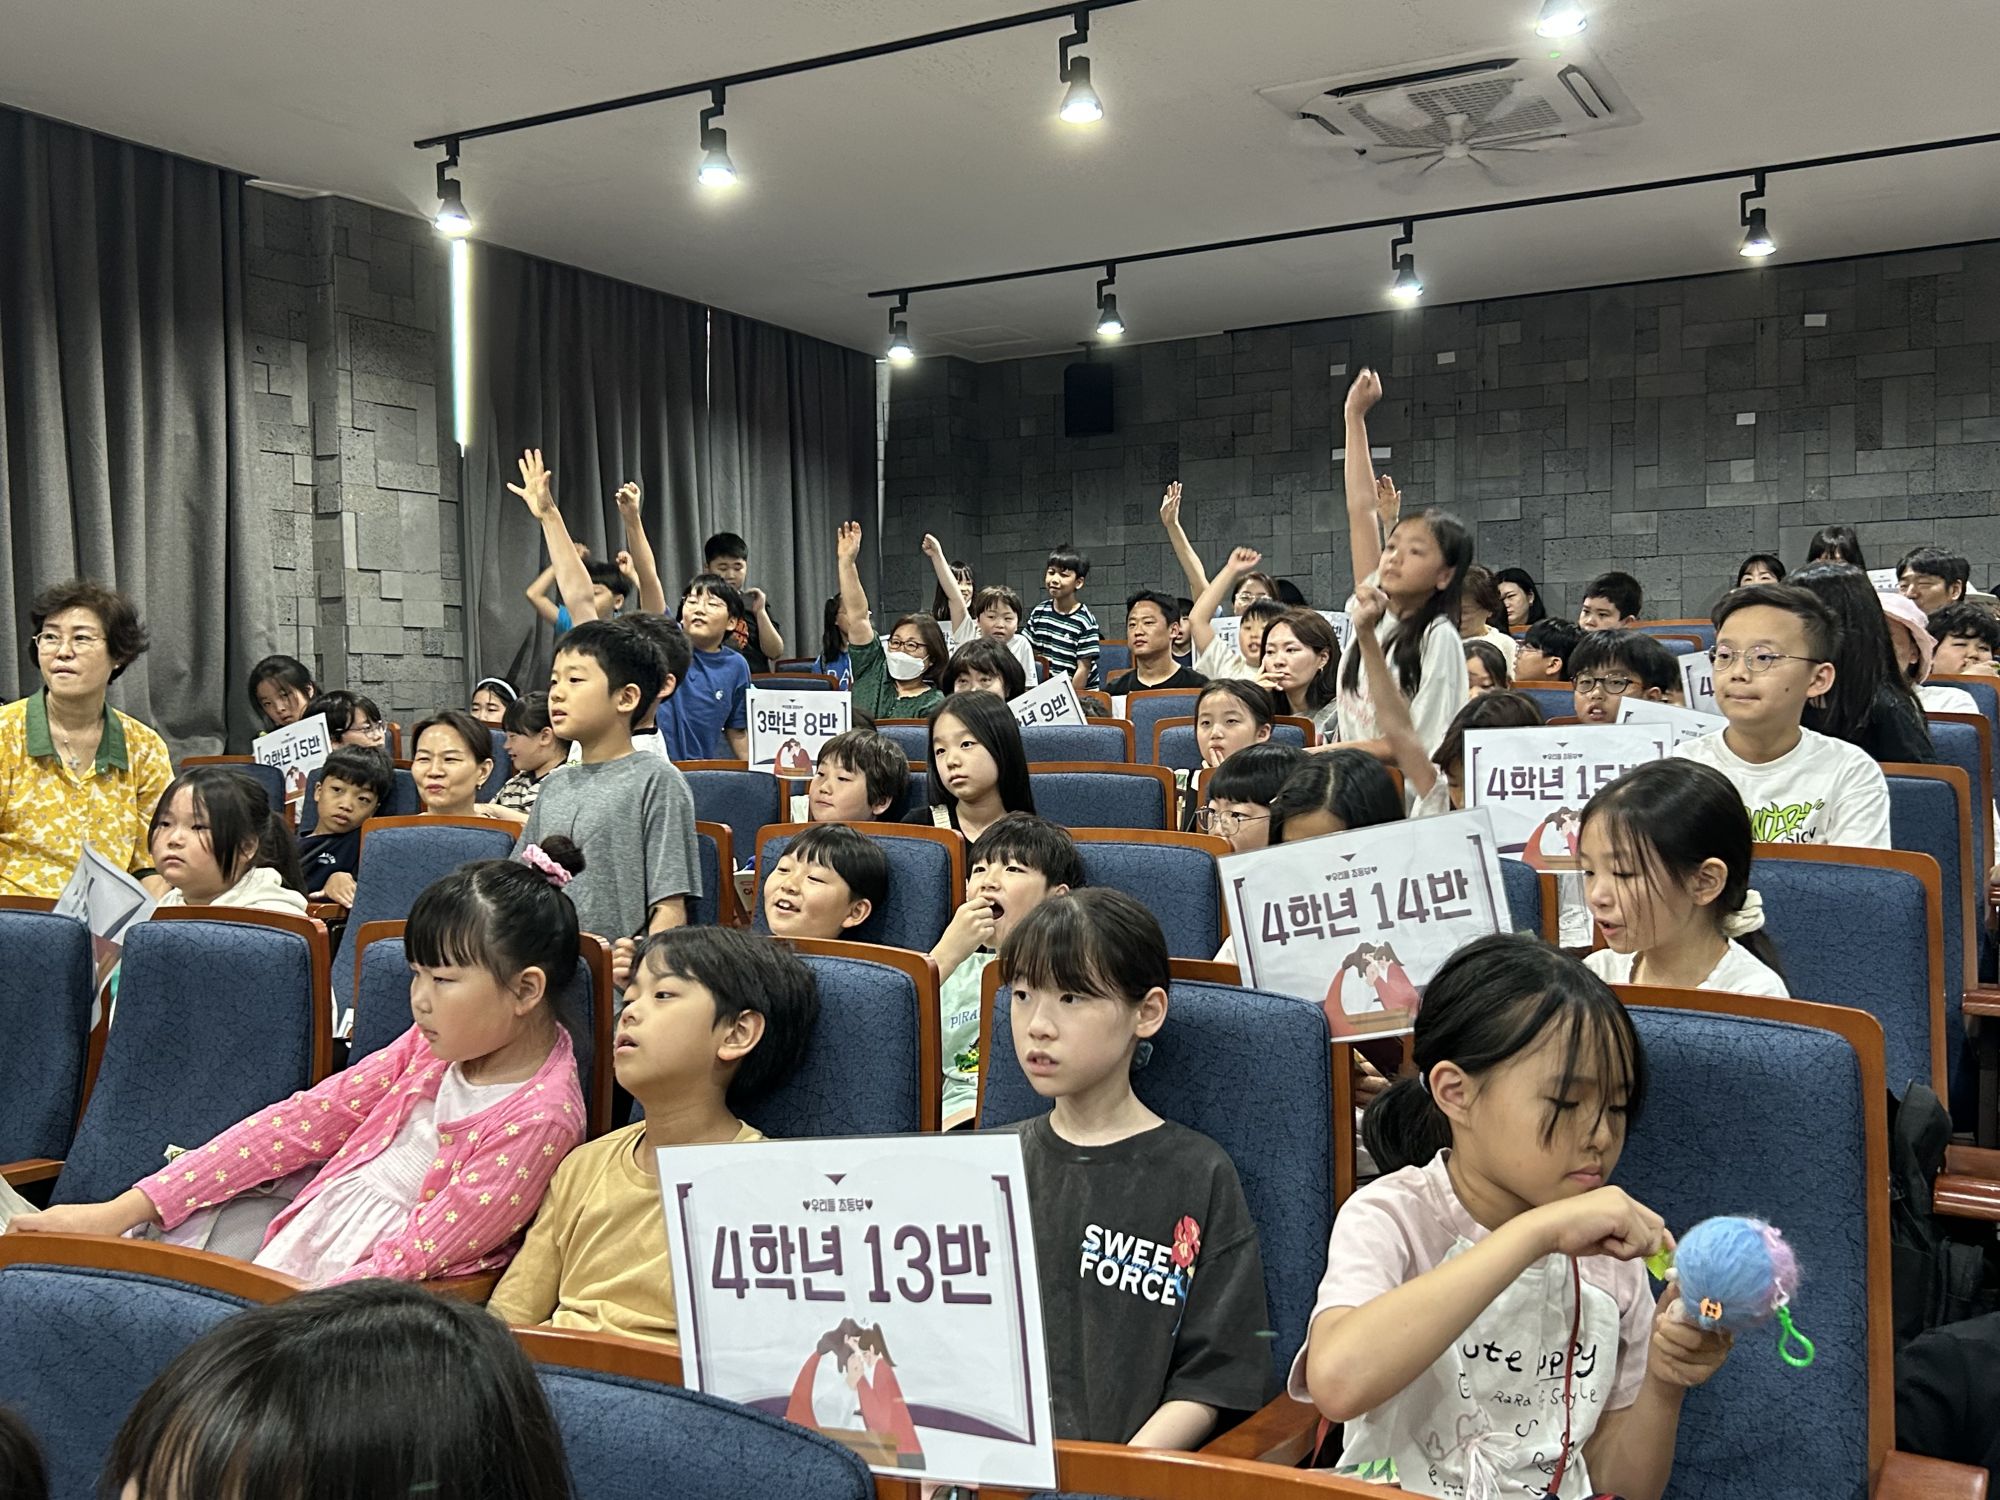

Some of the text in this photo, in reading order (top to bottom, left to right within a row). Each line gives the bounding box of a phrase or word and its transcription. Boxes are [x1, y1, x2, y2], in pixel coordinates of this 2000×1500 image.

[1041, 694, 1070, 722] 9반
[757, 711, 838, 736] 3학년 8반
[294, 735, 321, 760] 15반
[1487, 766, 1564, 800] 4학년
[1262, 869, 1472, 946] 4학년 14반
[950, 1009, 979, 1028] PIRA
[812, 1199, 864, 1212] 우리들 초등부
[712, 1225, 846, 1300] 4학년
[864, 1224, 992, 1304] 13반
[1080, 1252, 1178, 1306] FORCE
[1463, 1341, 1523, 1372] ute
